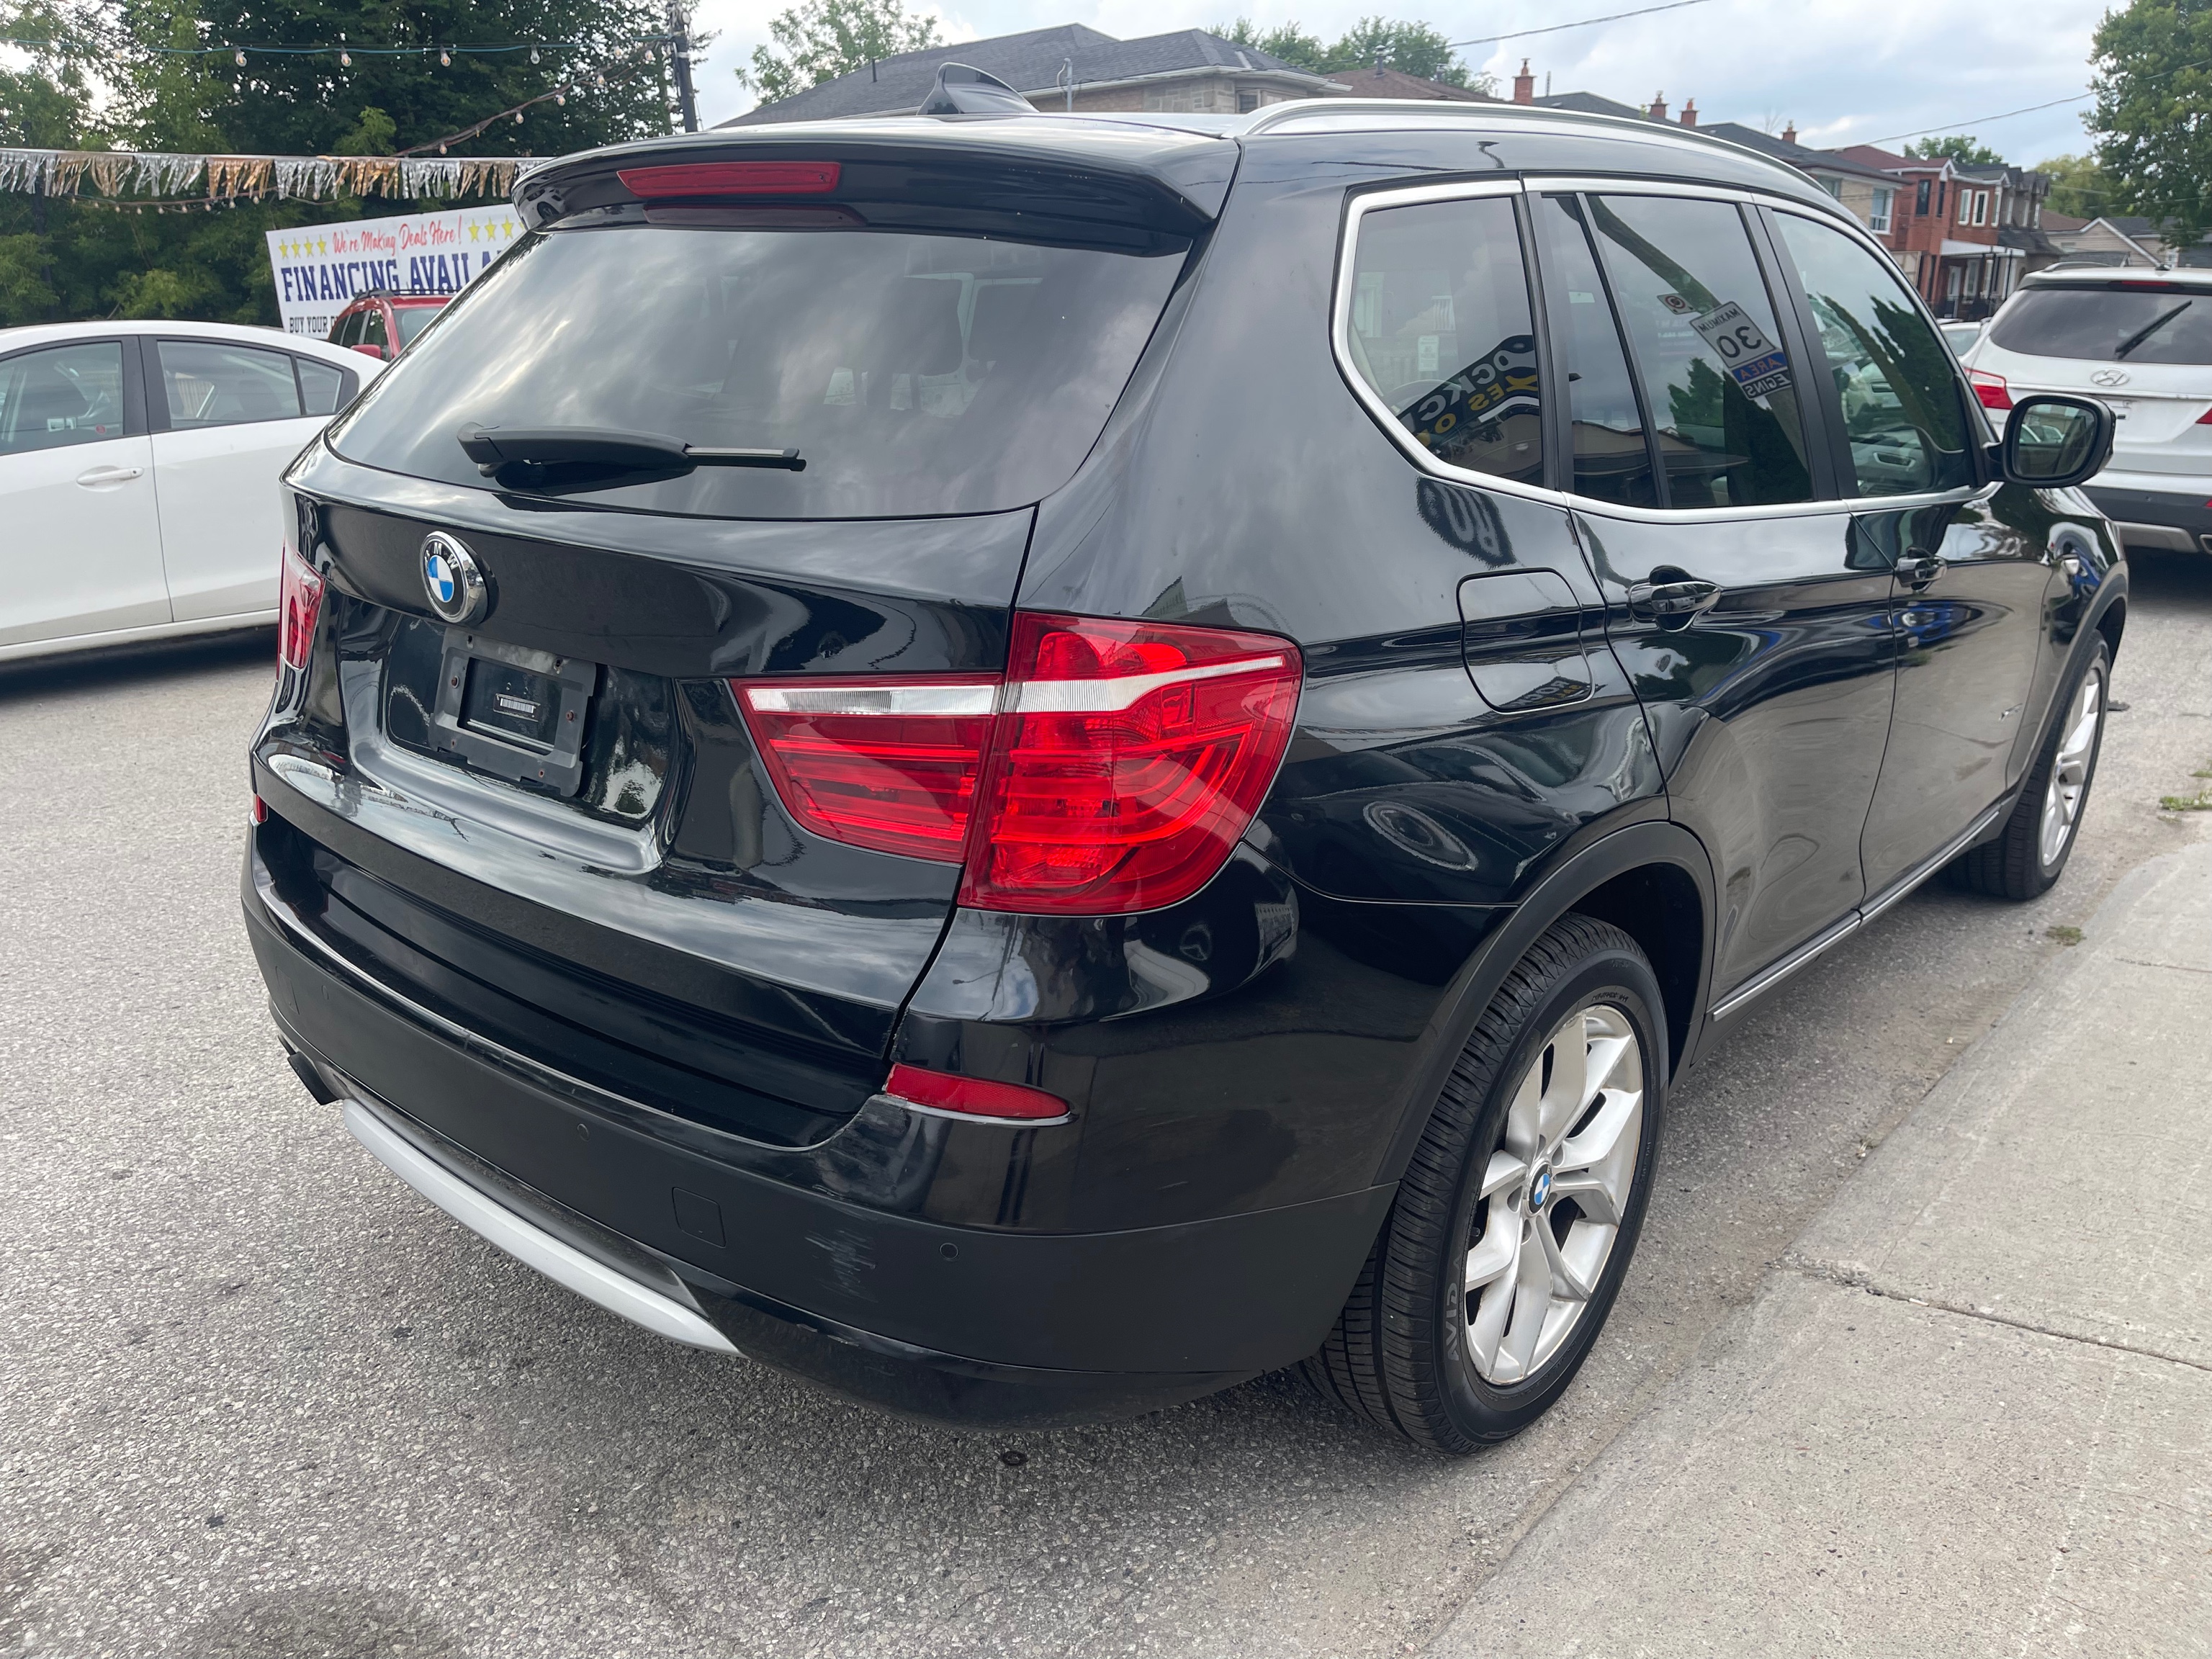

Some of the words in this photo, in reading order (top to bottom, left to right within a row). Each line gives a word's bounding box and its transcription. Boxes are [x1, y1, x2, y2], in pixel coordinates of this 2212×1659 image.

[333, 230, 359, 253] We're
[361, 230, 396, 256] Making
[398, 222, 427, 250] Deals
[429, 215, 462, 245] Here!
[281, 258, 400, 302] FINANCING
[410, 250, 503, 295] AVAIL
[289, 317, 305, 333] BUY
[307, 316, 328, 333] YOUR
